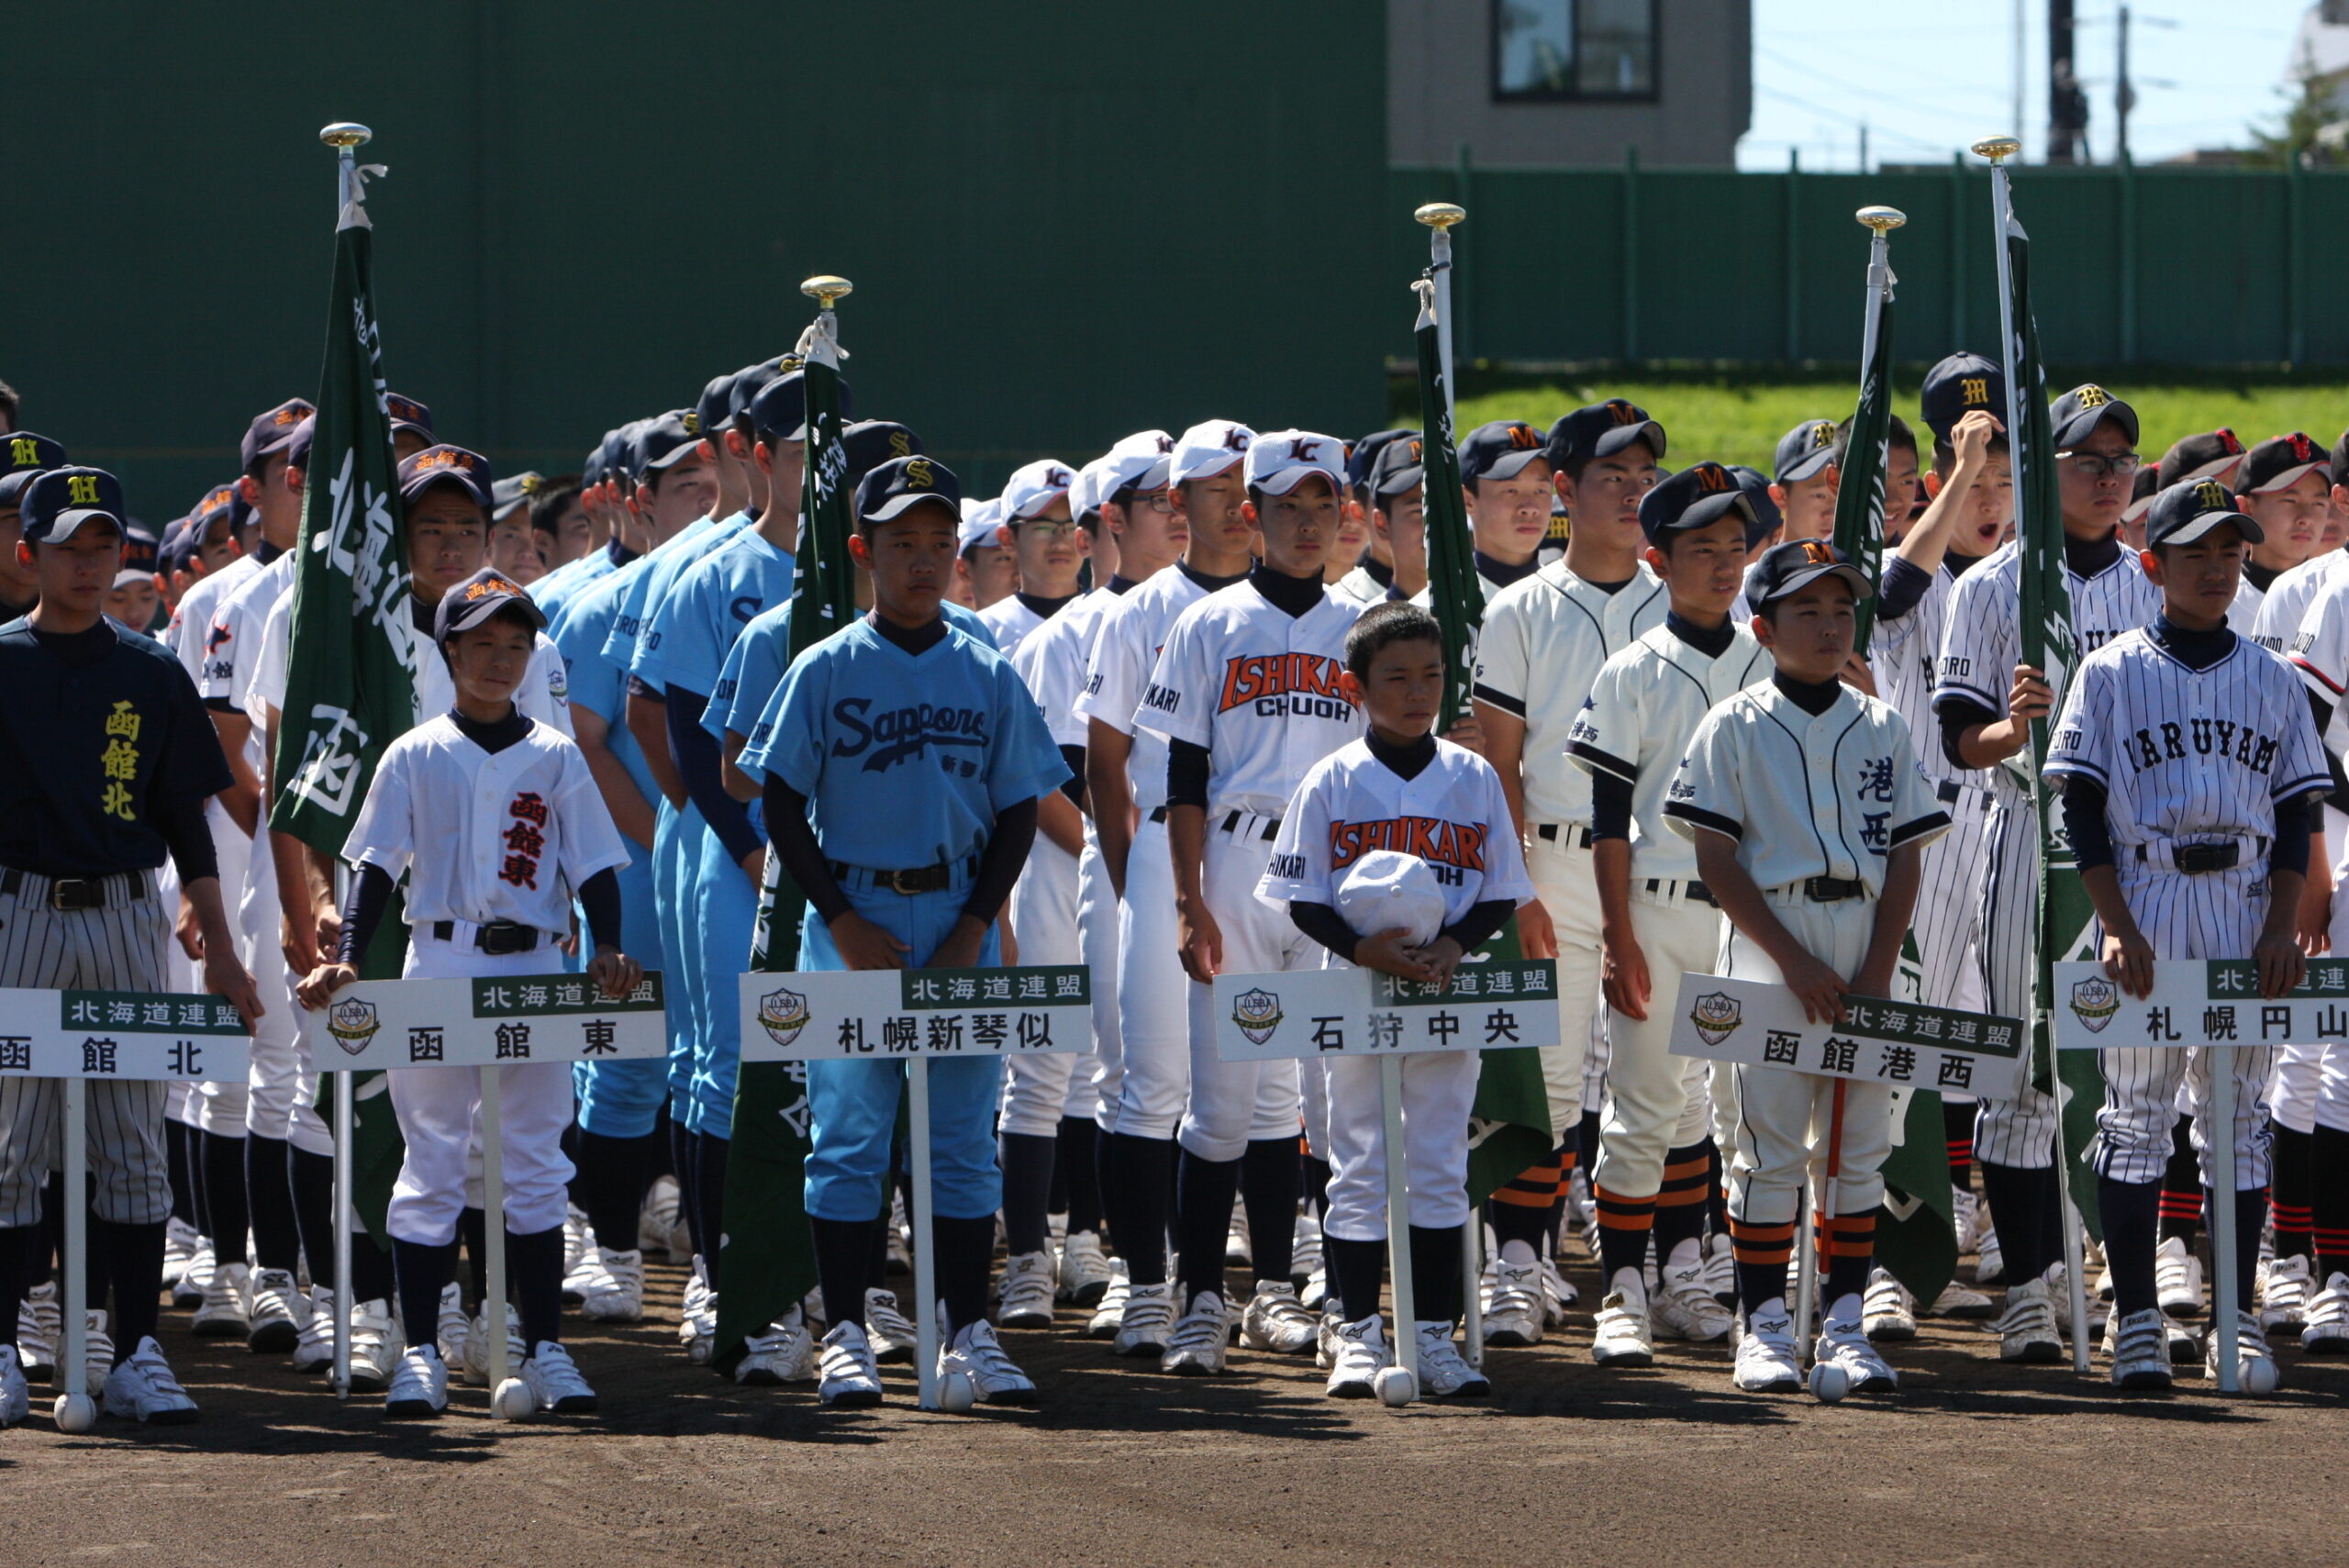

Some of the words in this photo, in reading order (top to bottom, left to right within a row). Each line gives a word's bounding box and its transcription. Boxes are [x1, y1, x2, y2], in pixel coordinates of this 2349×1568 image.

[1960, 378, 1989, 406] M
[1607, 403, 1636, 426] M
[1508, 426, 1539, 449] M
[11, 439, 40, 466] H
[907, 460, 934, 488] S
[1693, 466, 1730, 491] M
[68, 476, 100, 505] H
[2195, 482, 2227, 508] M
[1802, 542, 1839, 564] M
[101, 700, 141, 821] 函館北
[1857, 756, 1893, 856] 港西
[498, 792, 548, 891] 函館東
[911, 973, 1083, 1002] 北海道連盟
[71, 1000, 242, 1028] 北海道連盟
[1847, 1005, 2011, 1048] 北海道連盟
[2146, 1003, 2348, 1041] 札幌円山
[407, 1018, 618, 1062] 函館東
[837, 1012, 1053, 1053] 札幌新琴似
[1310, 1007, 1520, 1051] 石狩中央
[0, 1035, 204, 1076] 函館北
[1763, 1029, 1976, 1089] 函館港西
